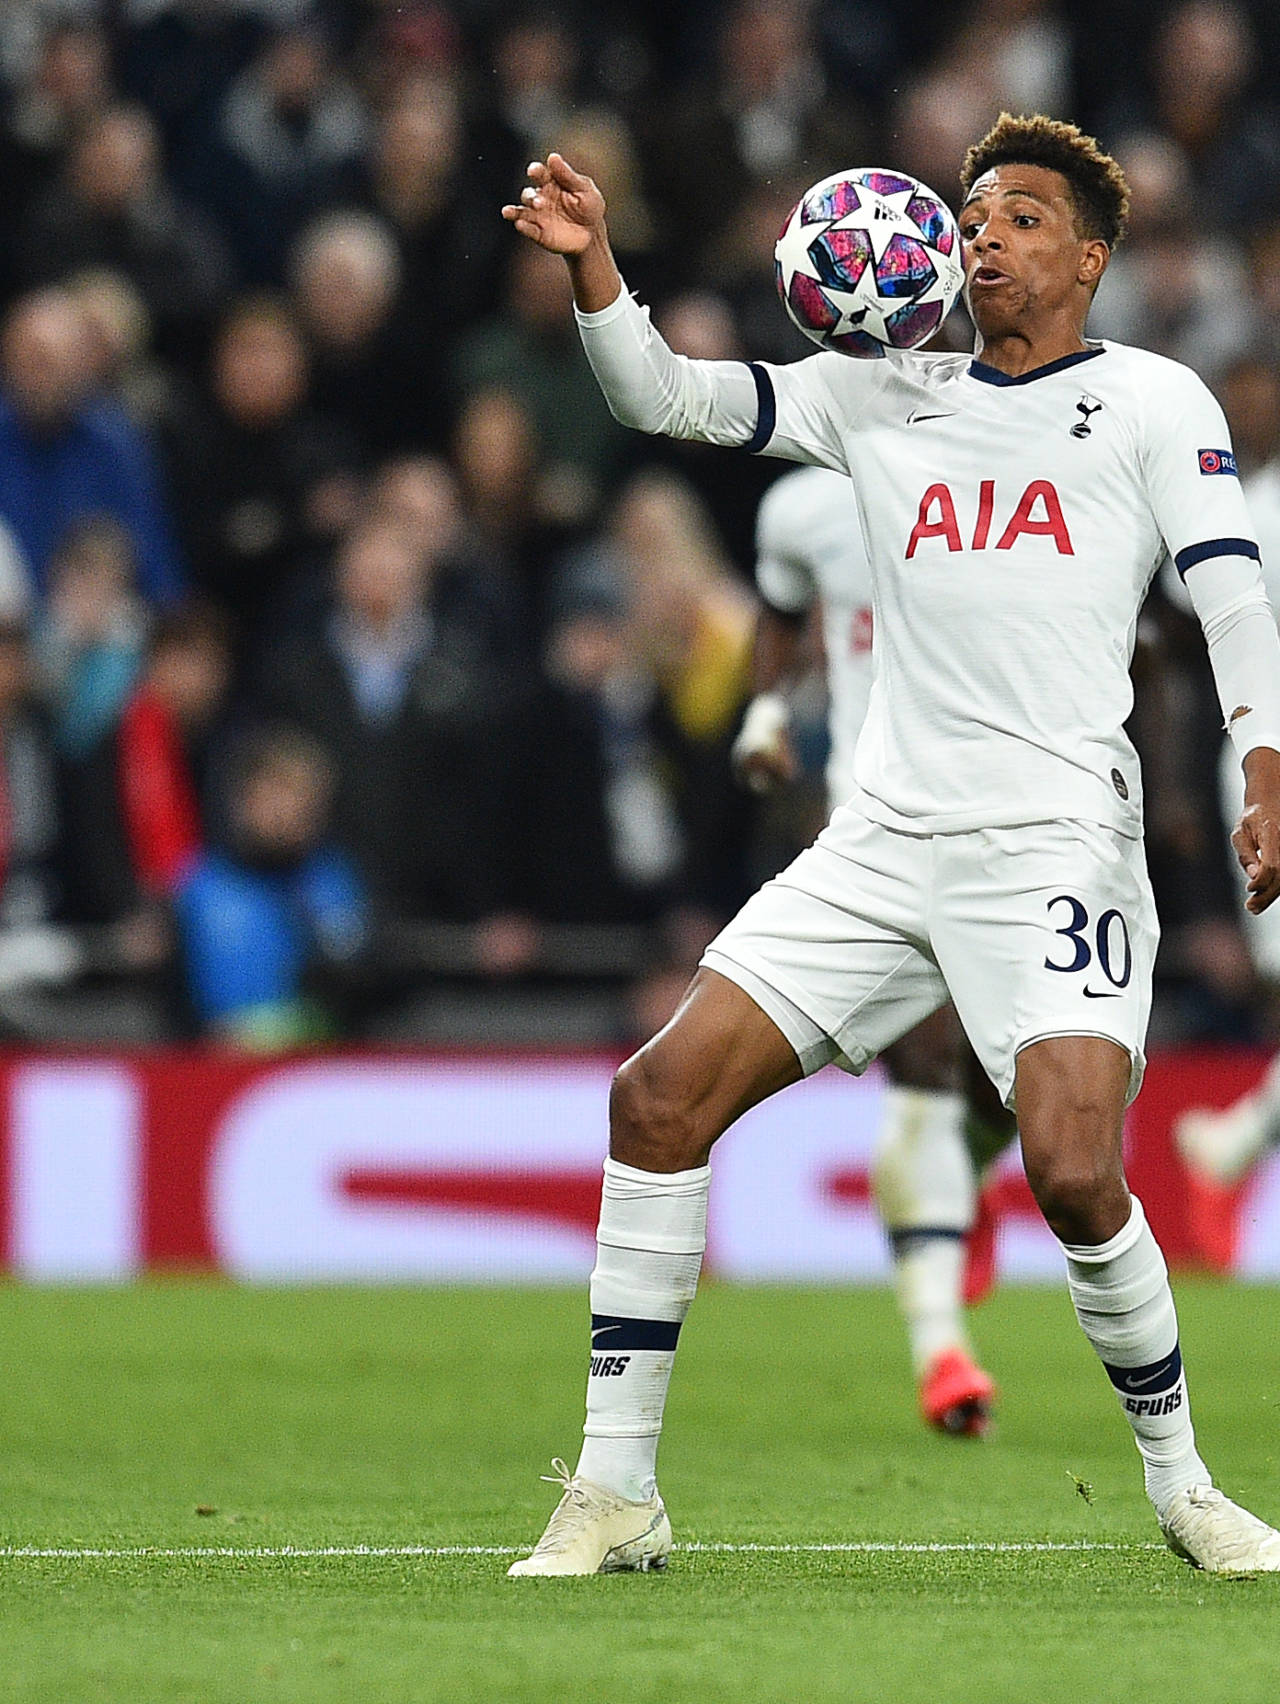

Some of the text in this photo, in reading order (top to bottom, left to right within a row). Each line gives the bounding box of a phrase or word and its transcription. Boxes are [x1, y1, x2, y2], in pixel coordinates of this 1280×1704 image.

[906, 479, 1074, 558] AIA
[1044, 895, 1132, 988] 30
[590, 1355, 631, 1377] URS
[1125, 1383, 1182, 1417] SPURS
